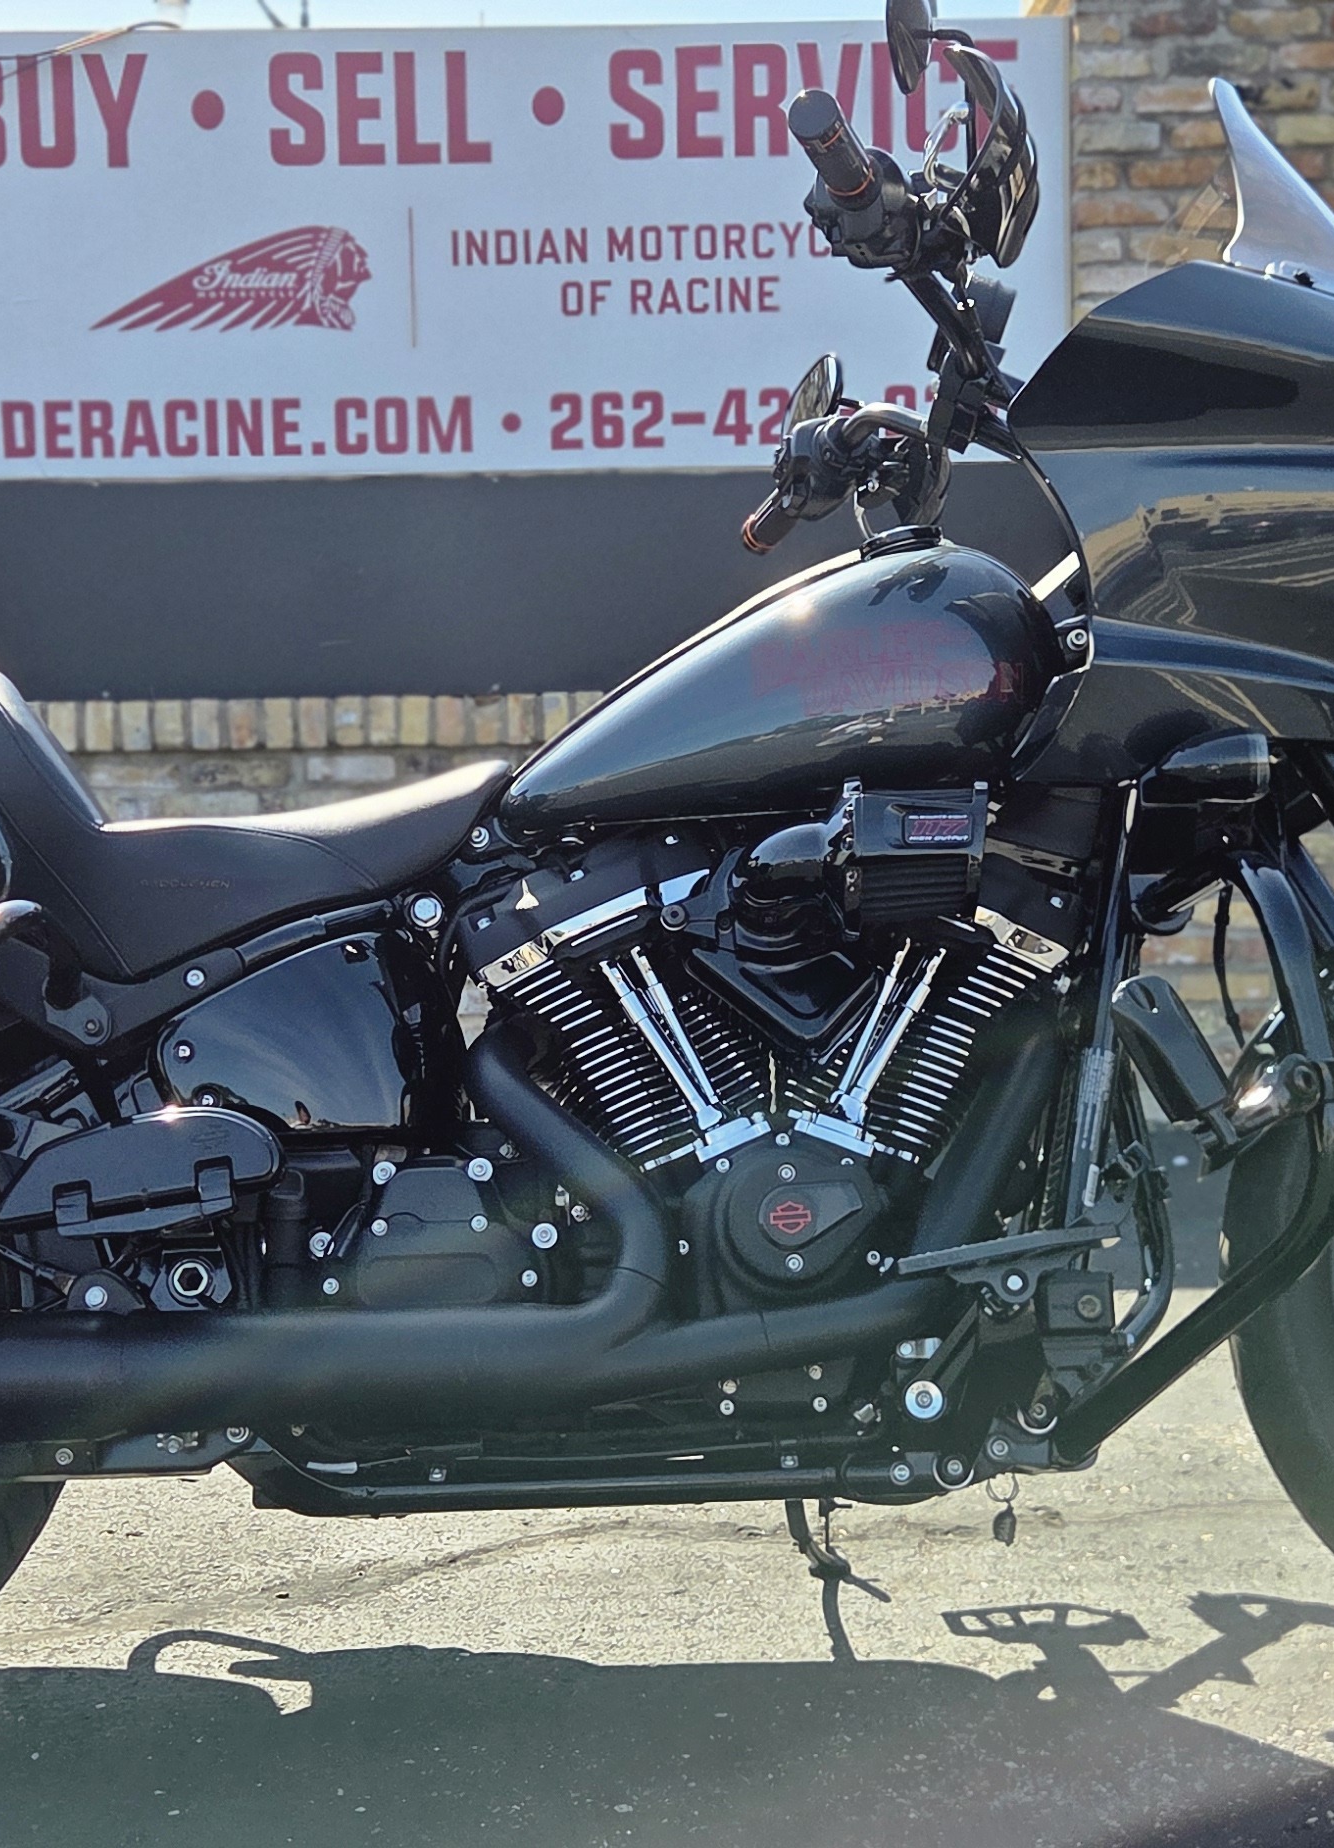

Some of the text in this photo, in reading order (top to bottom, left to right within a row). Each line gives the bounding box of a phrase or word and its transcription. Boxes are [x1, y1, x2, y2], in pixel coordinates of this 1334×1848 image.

[268, 51, 492, 166] SELL
[450, 221, 831, 266] INDIAN MOTORCYC
[192, 260, 297, 291] Indian
[560, 275, 781, 317] OF RACINE
[911, 819, 969, 836] 117
